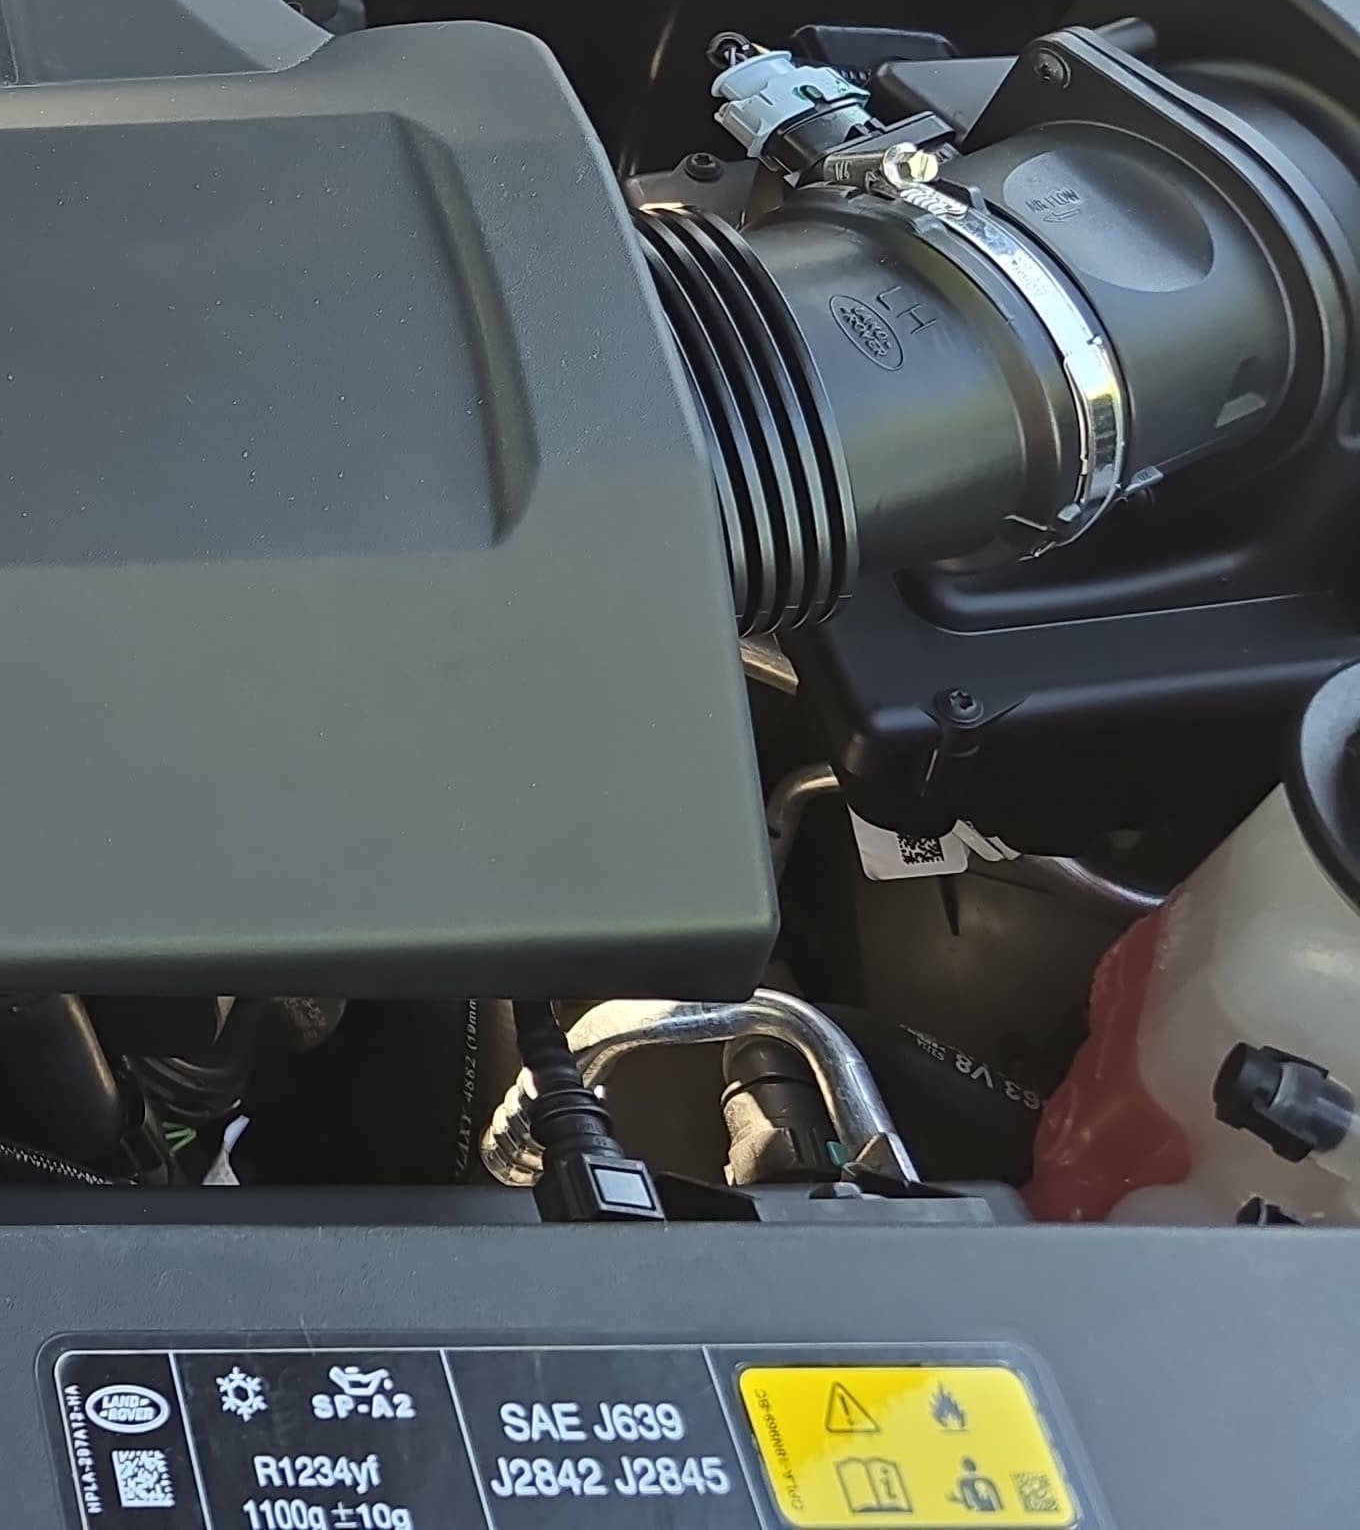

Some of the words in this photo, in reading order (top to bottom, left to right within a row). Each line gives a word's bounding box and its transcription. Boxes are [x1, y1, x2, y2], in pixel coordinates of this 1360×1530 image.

[876, 286, 937, 334] LH
[102, 1394, 140, 1409] LAND
[107, 1406, 155, 1422] ROVER
[311, 1393, 416, 1419] SP-A2
[499, 1402, 587, 1442] SAE
[592, 1402, 685, 1442] J639
[253, 1453, 381, 1494] R1234yf
[489, 1456, 609, 1497] J2842
[613, 1455, 730, 1496] J2845
